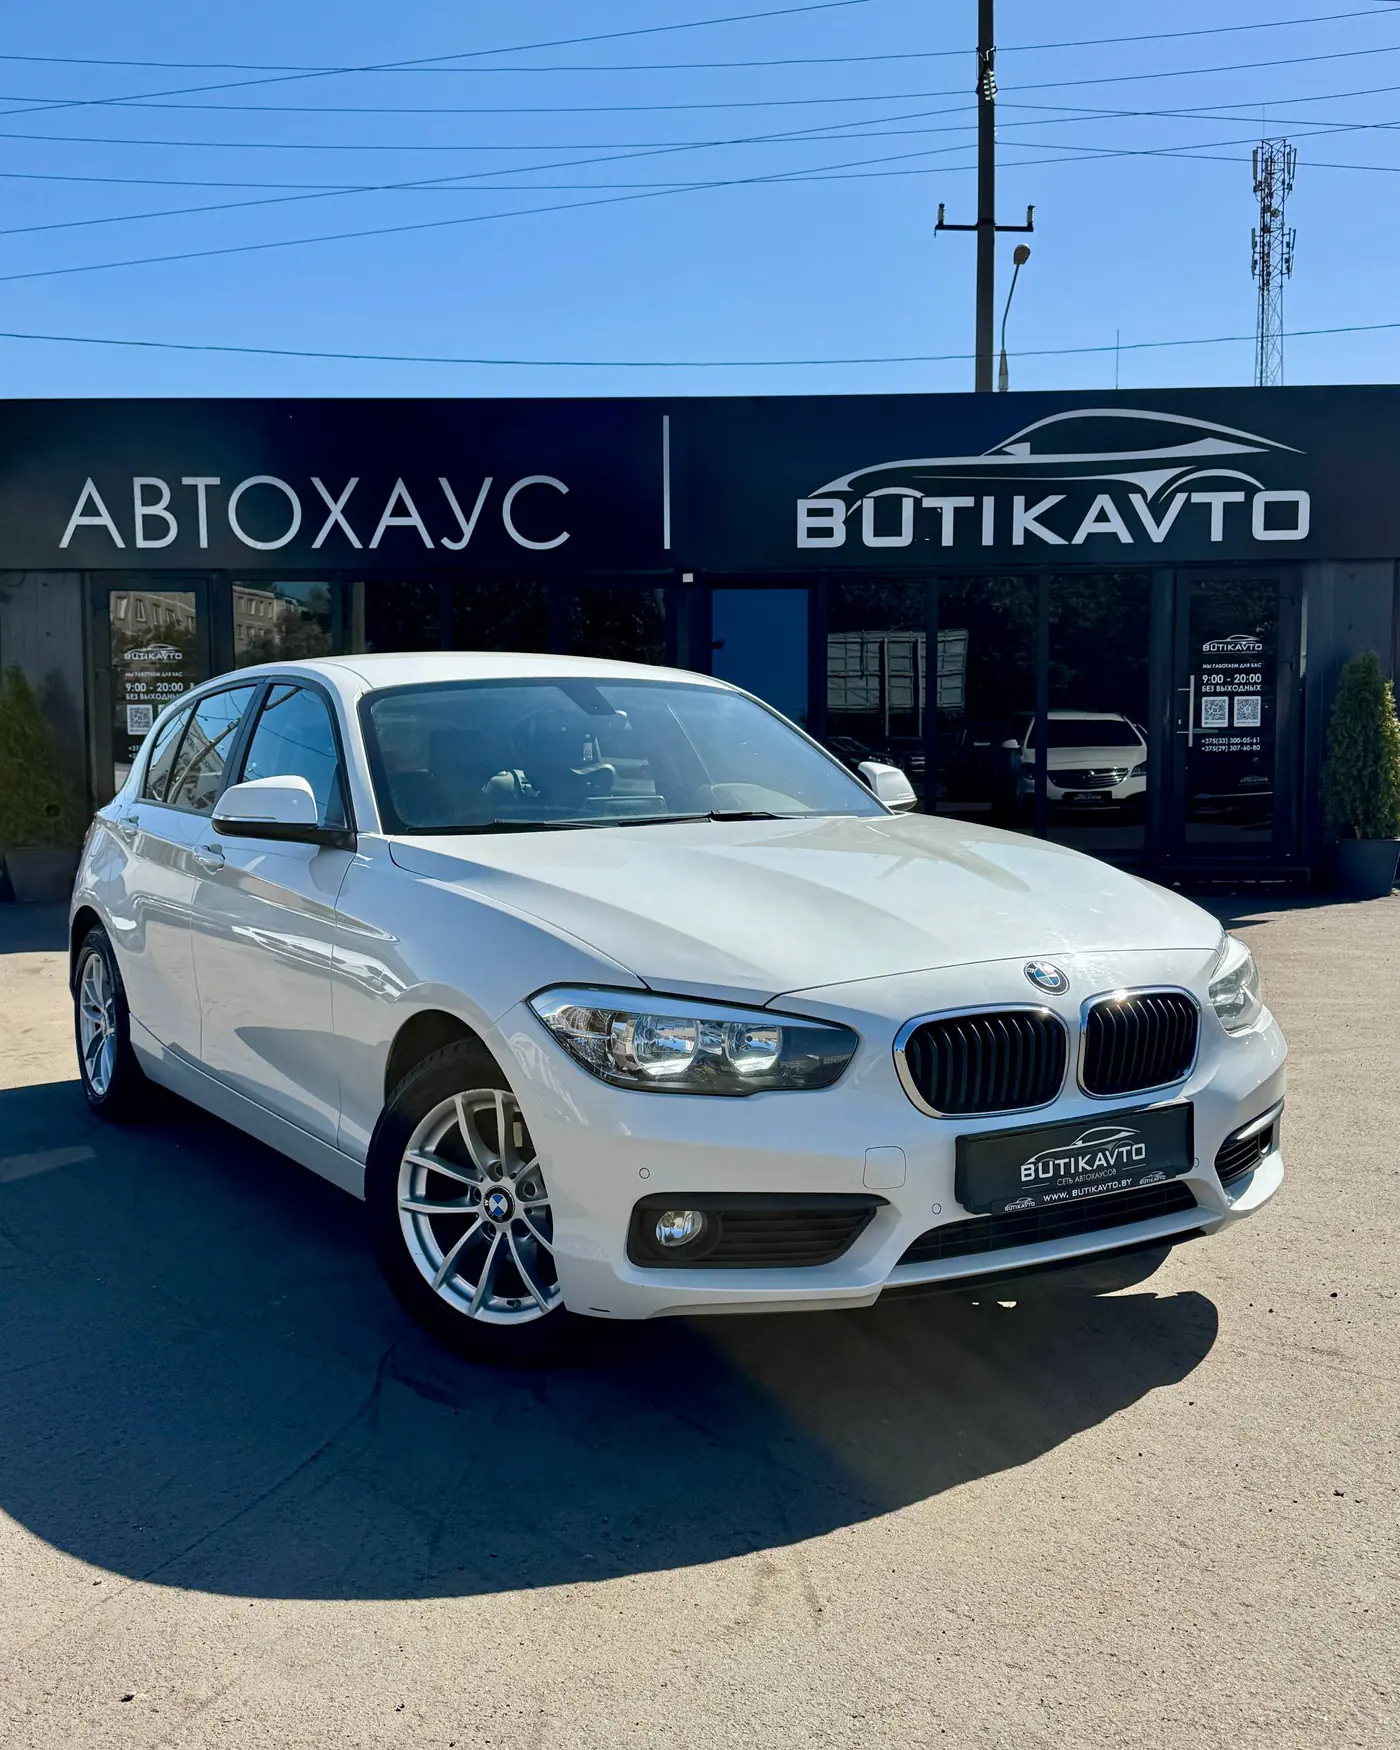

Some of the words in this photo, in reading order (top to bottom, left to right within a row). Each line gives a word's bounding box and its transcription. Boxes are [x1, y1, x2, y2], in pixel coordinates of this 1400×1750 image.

[59, 475, 571, 550] АВТОХАУС
[797, 489, 1310, 549] BUTIKAVTO
[1202, 643, 1263, 652] BUTIKAVTO
[1202, 674, 1224, 684] 9:00
[1233, 673, 1262, 683] 20:00
[125, 682, 147, 692] 9:00
[156, 682, 184, 692] 20:00
[1216, 684, 1262, 692] ВЫХОДНЫХ
[1201, 745, 1228, 753] +375(29)
[1020, 1143, 1146, 1181] BUTIKAVTO
[1056, 1177, 1074, 1187] СЕТЬ
[1074, 1168, 1117, 1183] АВТОХАУСОВ
[1043, 1190, 1069, 1202] WWW.
[1072, 1178, 1133, 1197] BUTIKAVTO.BY
[1004, 1201, 1036, 1212] BUTIKAVTO
